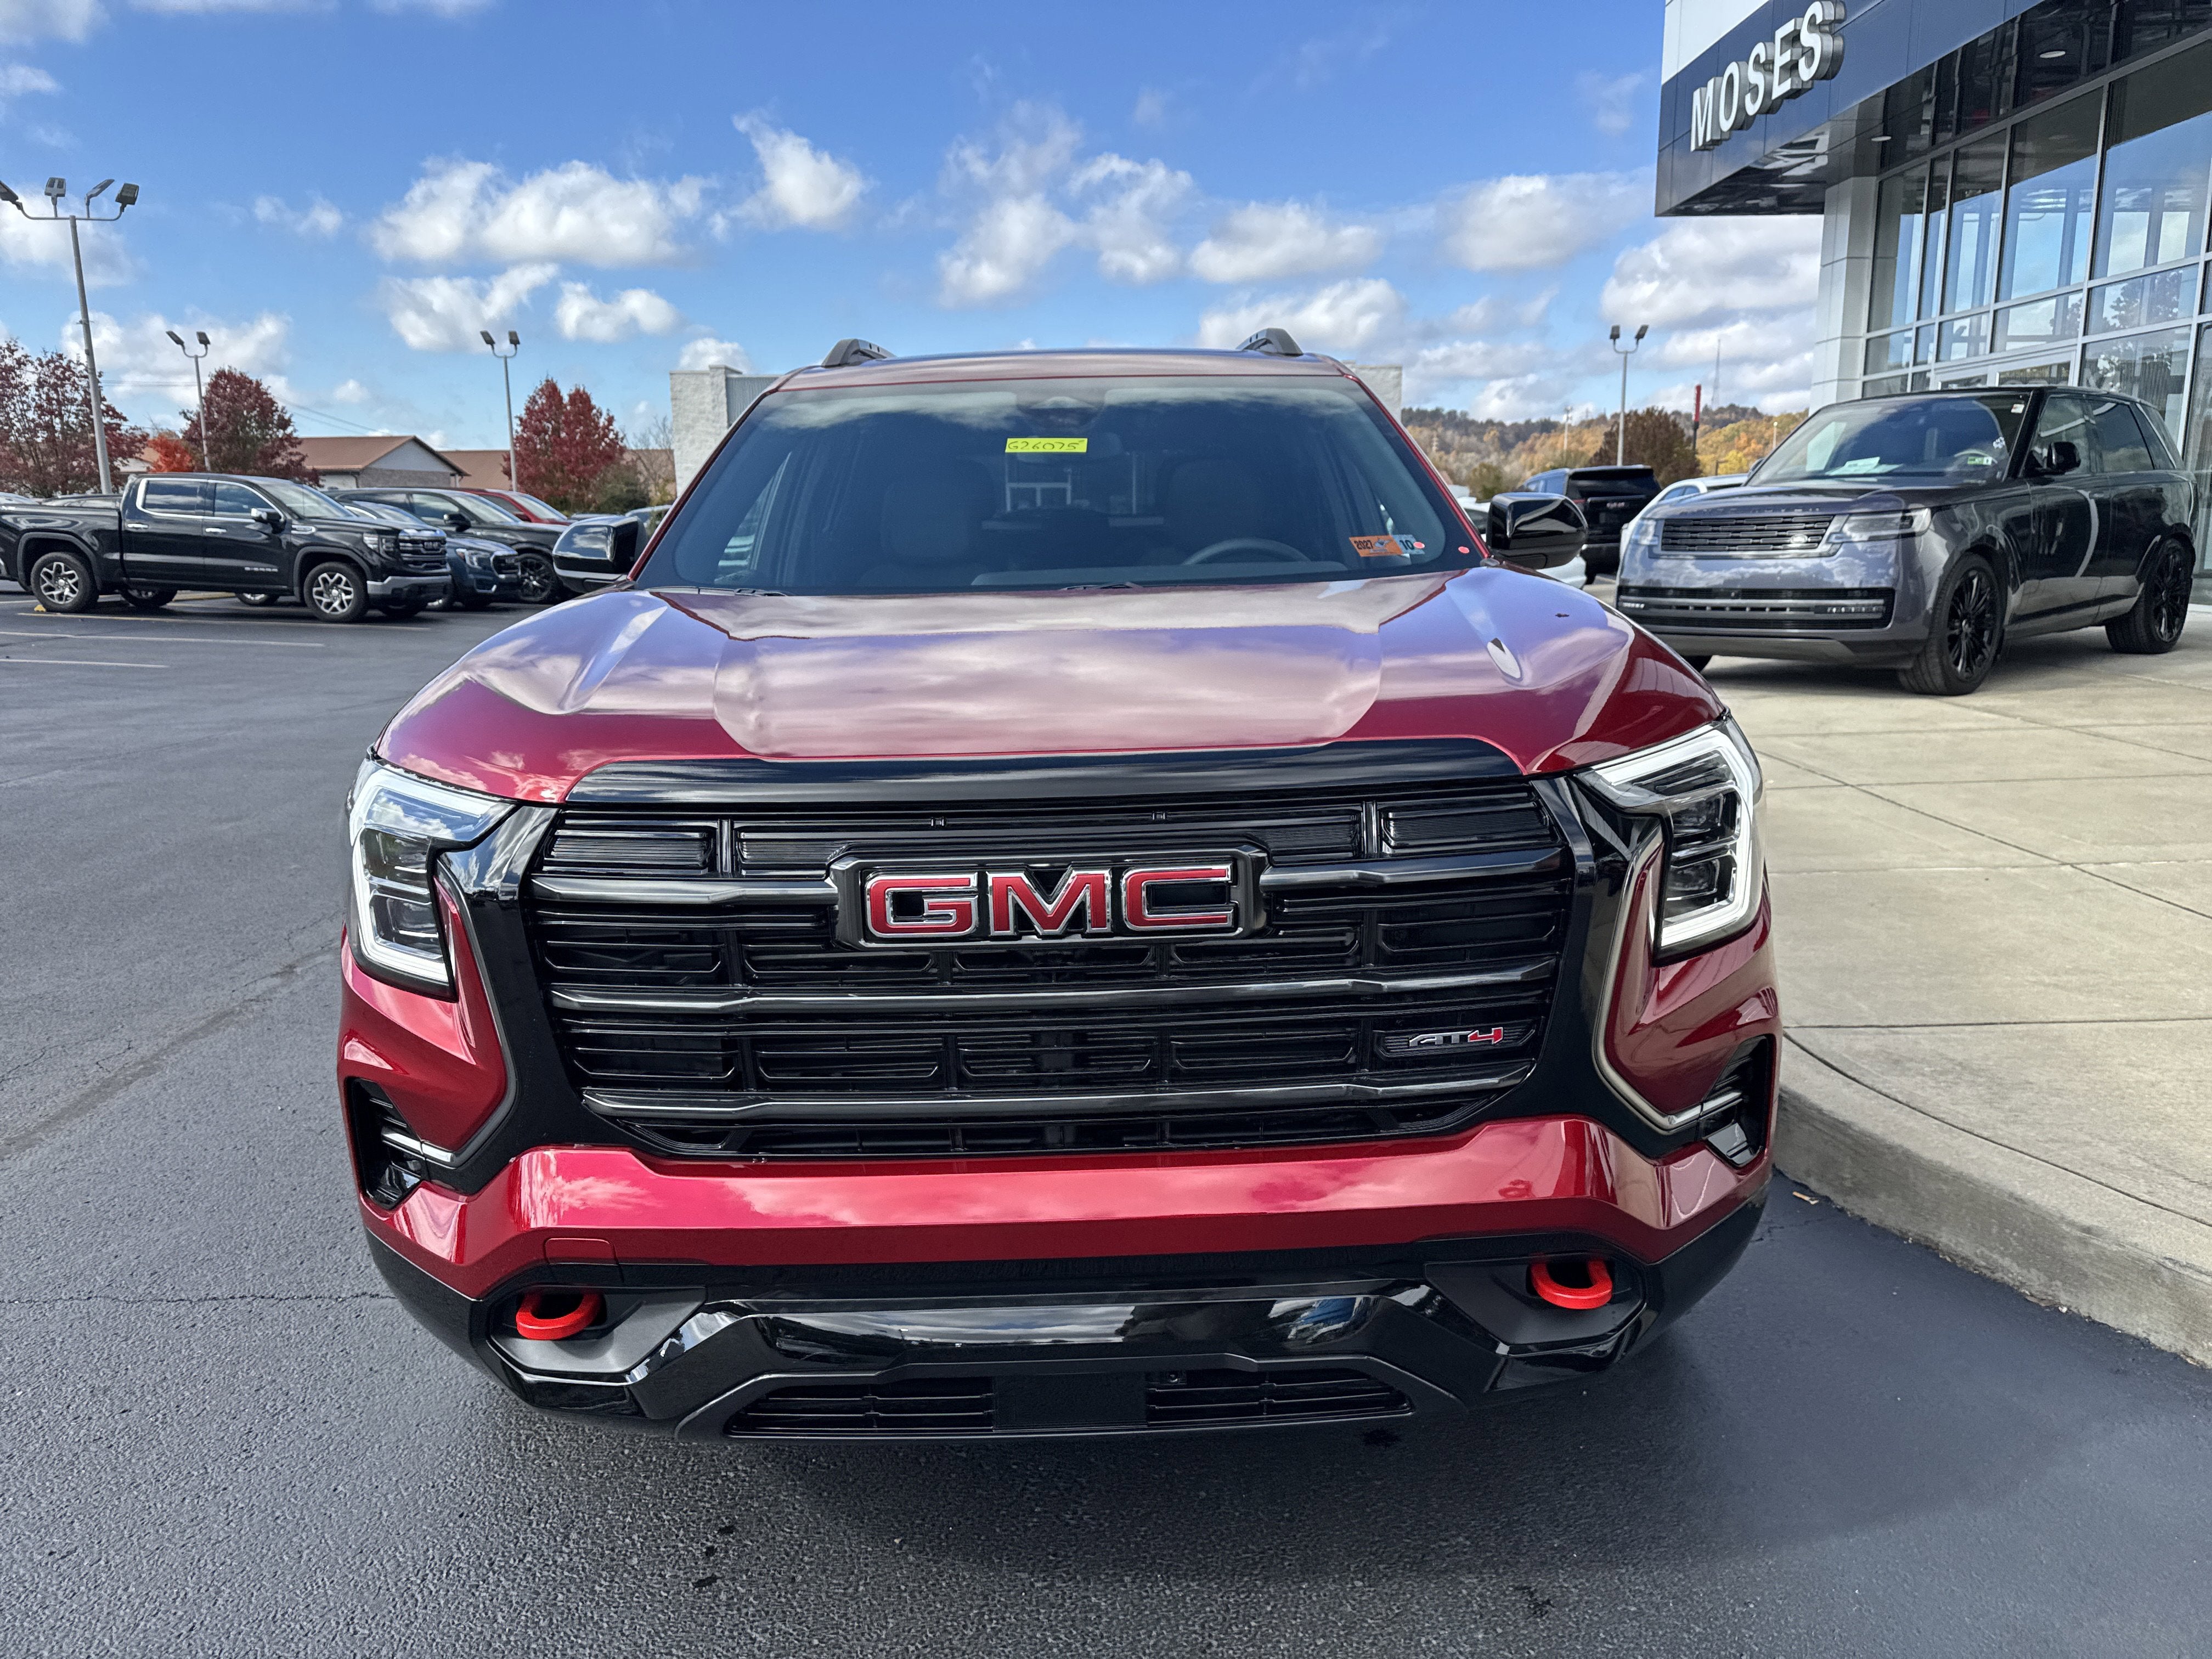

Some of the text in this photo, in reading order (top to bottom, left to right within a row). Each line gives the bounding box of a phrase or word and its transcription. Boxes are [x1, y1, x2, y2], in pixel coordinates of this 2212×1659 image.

[1690, 1, 1836, 153] MOSES
[1007, 440, 1085, 450] G26075
[1399, 539, 1415, 550] 10
[865, 865, 1234, 938] GMC
[1409, 1026, 1504, 1047] AT4
